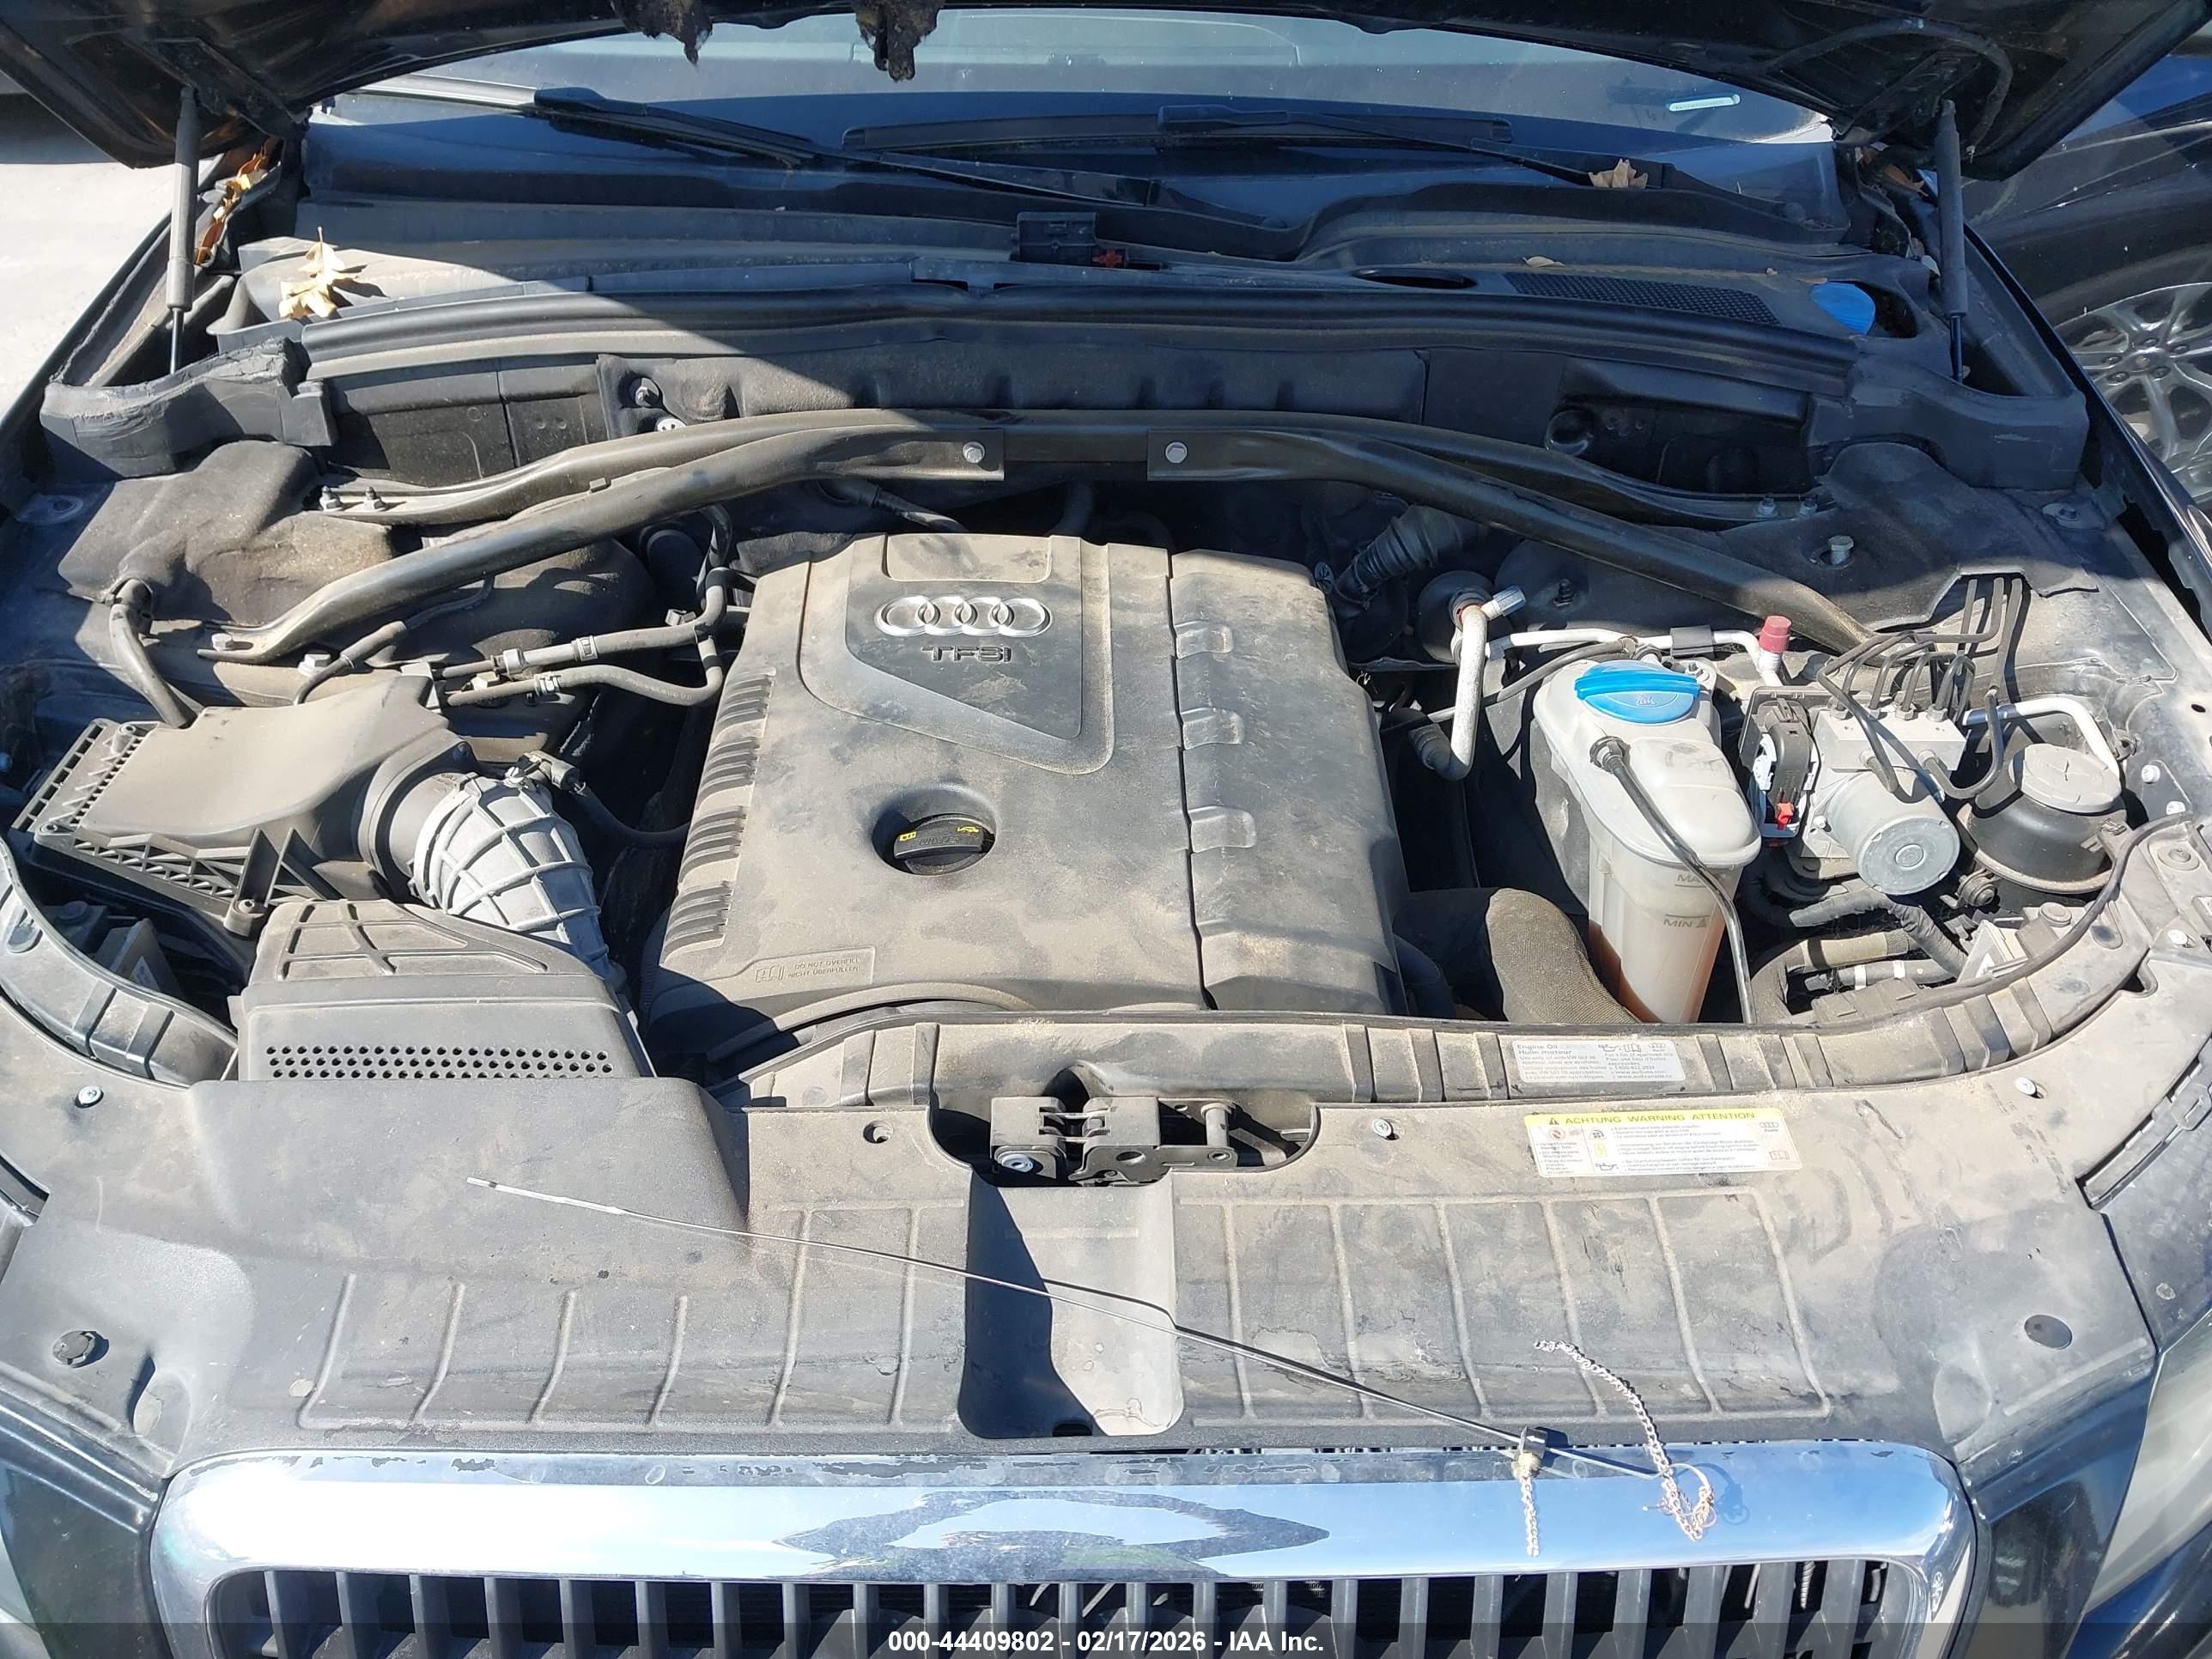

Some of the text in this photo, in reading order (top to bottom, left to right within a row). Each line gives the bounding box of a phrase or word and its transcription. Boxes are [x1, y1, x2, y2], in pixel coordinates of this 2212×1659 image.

[1677, 874, 1702, 883] MA
[1663, 919, 1692, 928] MIN
[1565, 1112, 1755, 1125] ACHTUNG WARNING ATTENTION
